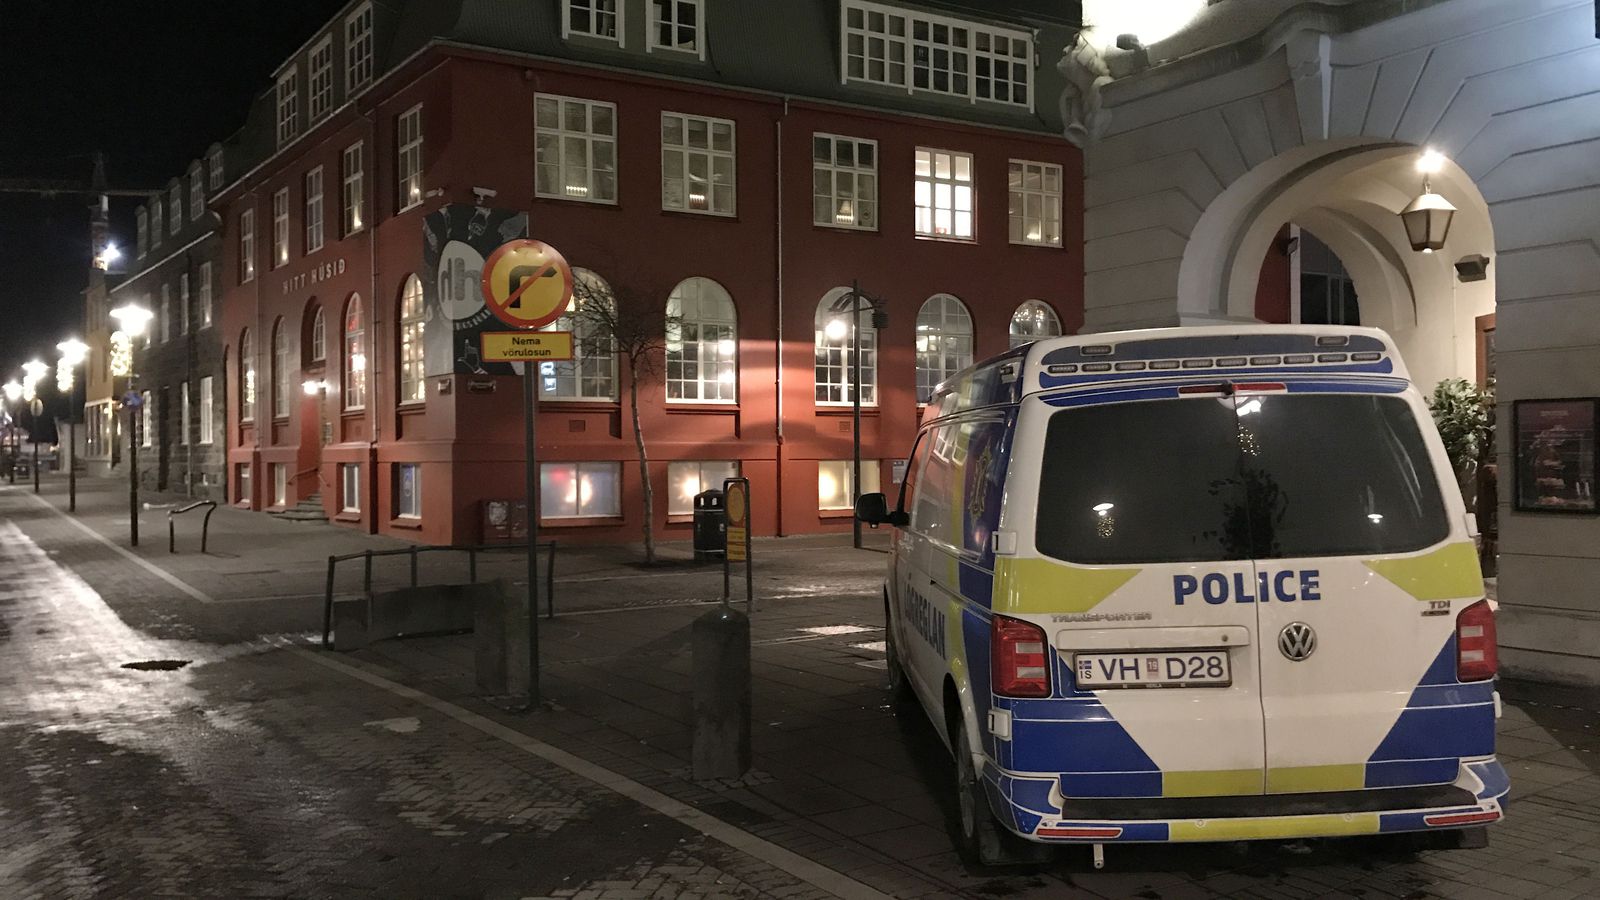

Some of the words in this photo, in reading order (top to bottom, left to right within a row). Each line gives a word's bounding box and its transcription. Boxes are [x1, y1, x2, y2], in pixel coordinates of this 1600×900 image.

[282, 273, 306, 295] HITT
[512, 337, 541, 345] Nema
[503, 348, 552, 357] vörulosun
[1173, 570, 1321, 605] POLICE
[1429, 600, 1451, 609] TDI
[1051, 613, 1152, 623] TRANSPORTER
[1098, 658, 1140, 680] VH
[1166, 656, 1224, 680] D28
[1080, 670, 1092, 679] IS
